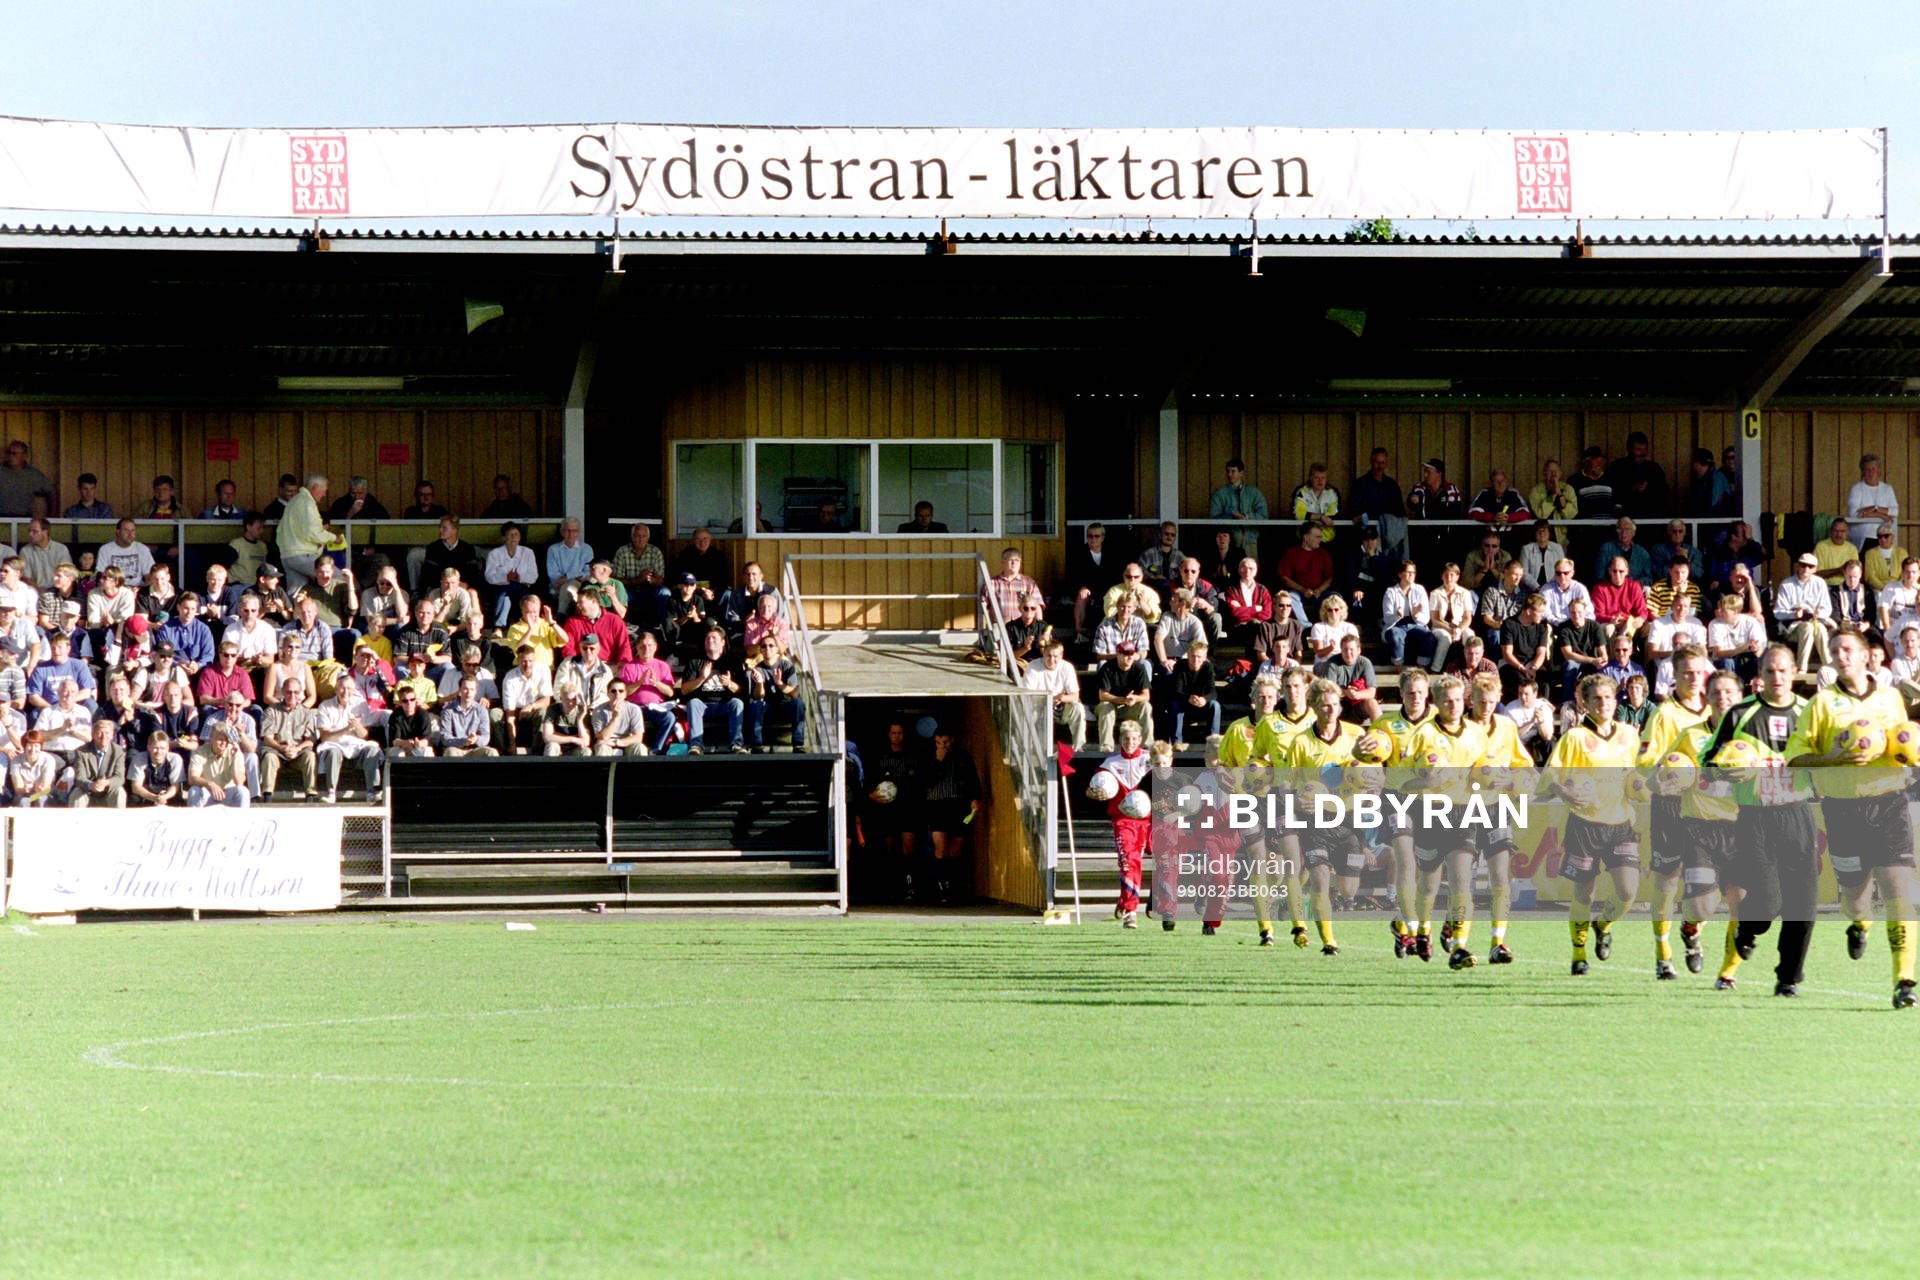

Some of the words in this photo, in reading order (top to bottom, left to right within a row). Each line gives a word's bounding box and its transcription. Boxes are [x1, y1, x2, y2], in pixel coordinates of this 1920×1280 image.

[291, 138, 345, 162] SYD
[1515, 138, 1567, 162] SYD
[295, 187, 347, 210] RAN
[1519, 187, 1570, 209] RAN
[1745, 412, 1758, 438] C
